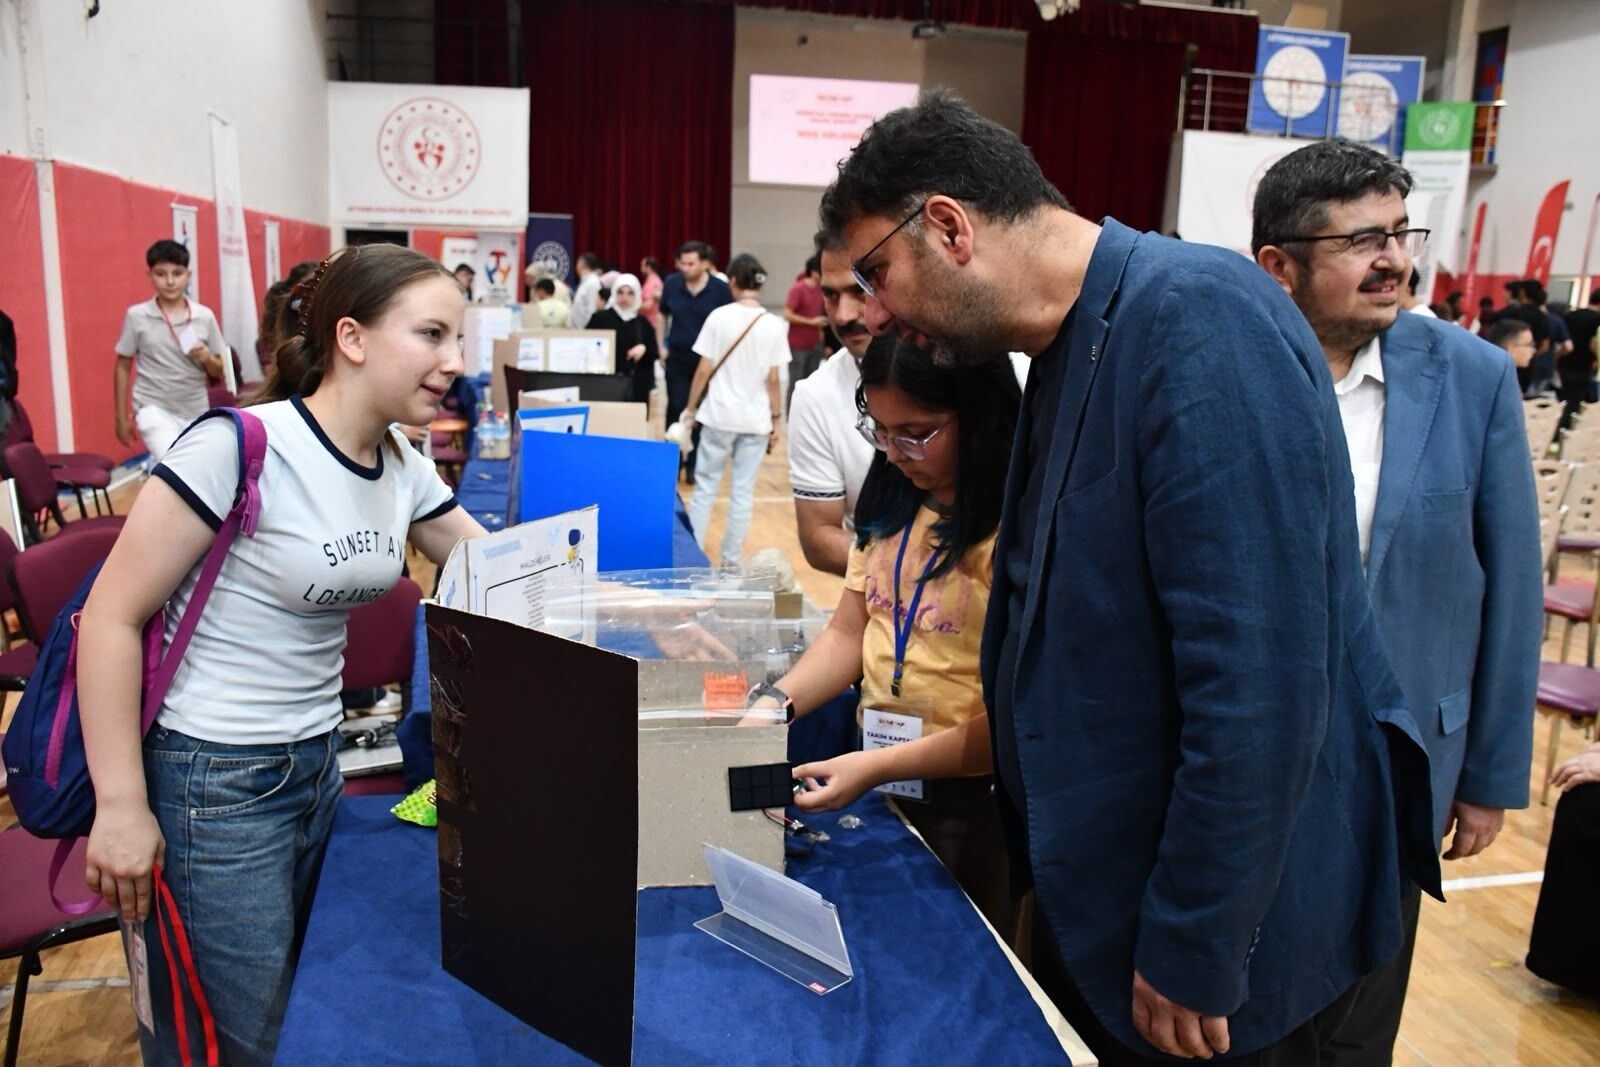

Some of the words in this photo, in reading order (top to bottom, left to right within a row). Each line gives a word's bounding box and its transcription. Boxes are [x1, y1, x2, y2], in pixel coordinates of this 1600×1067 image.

[323, 530, 380, 567] SUNSET
[303, 583, 345, 605] LOS
[888, 734, 914, 743] KAPTA
